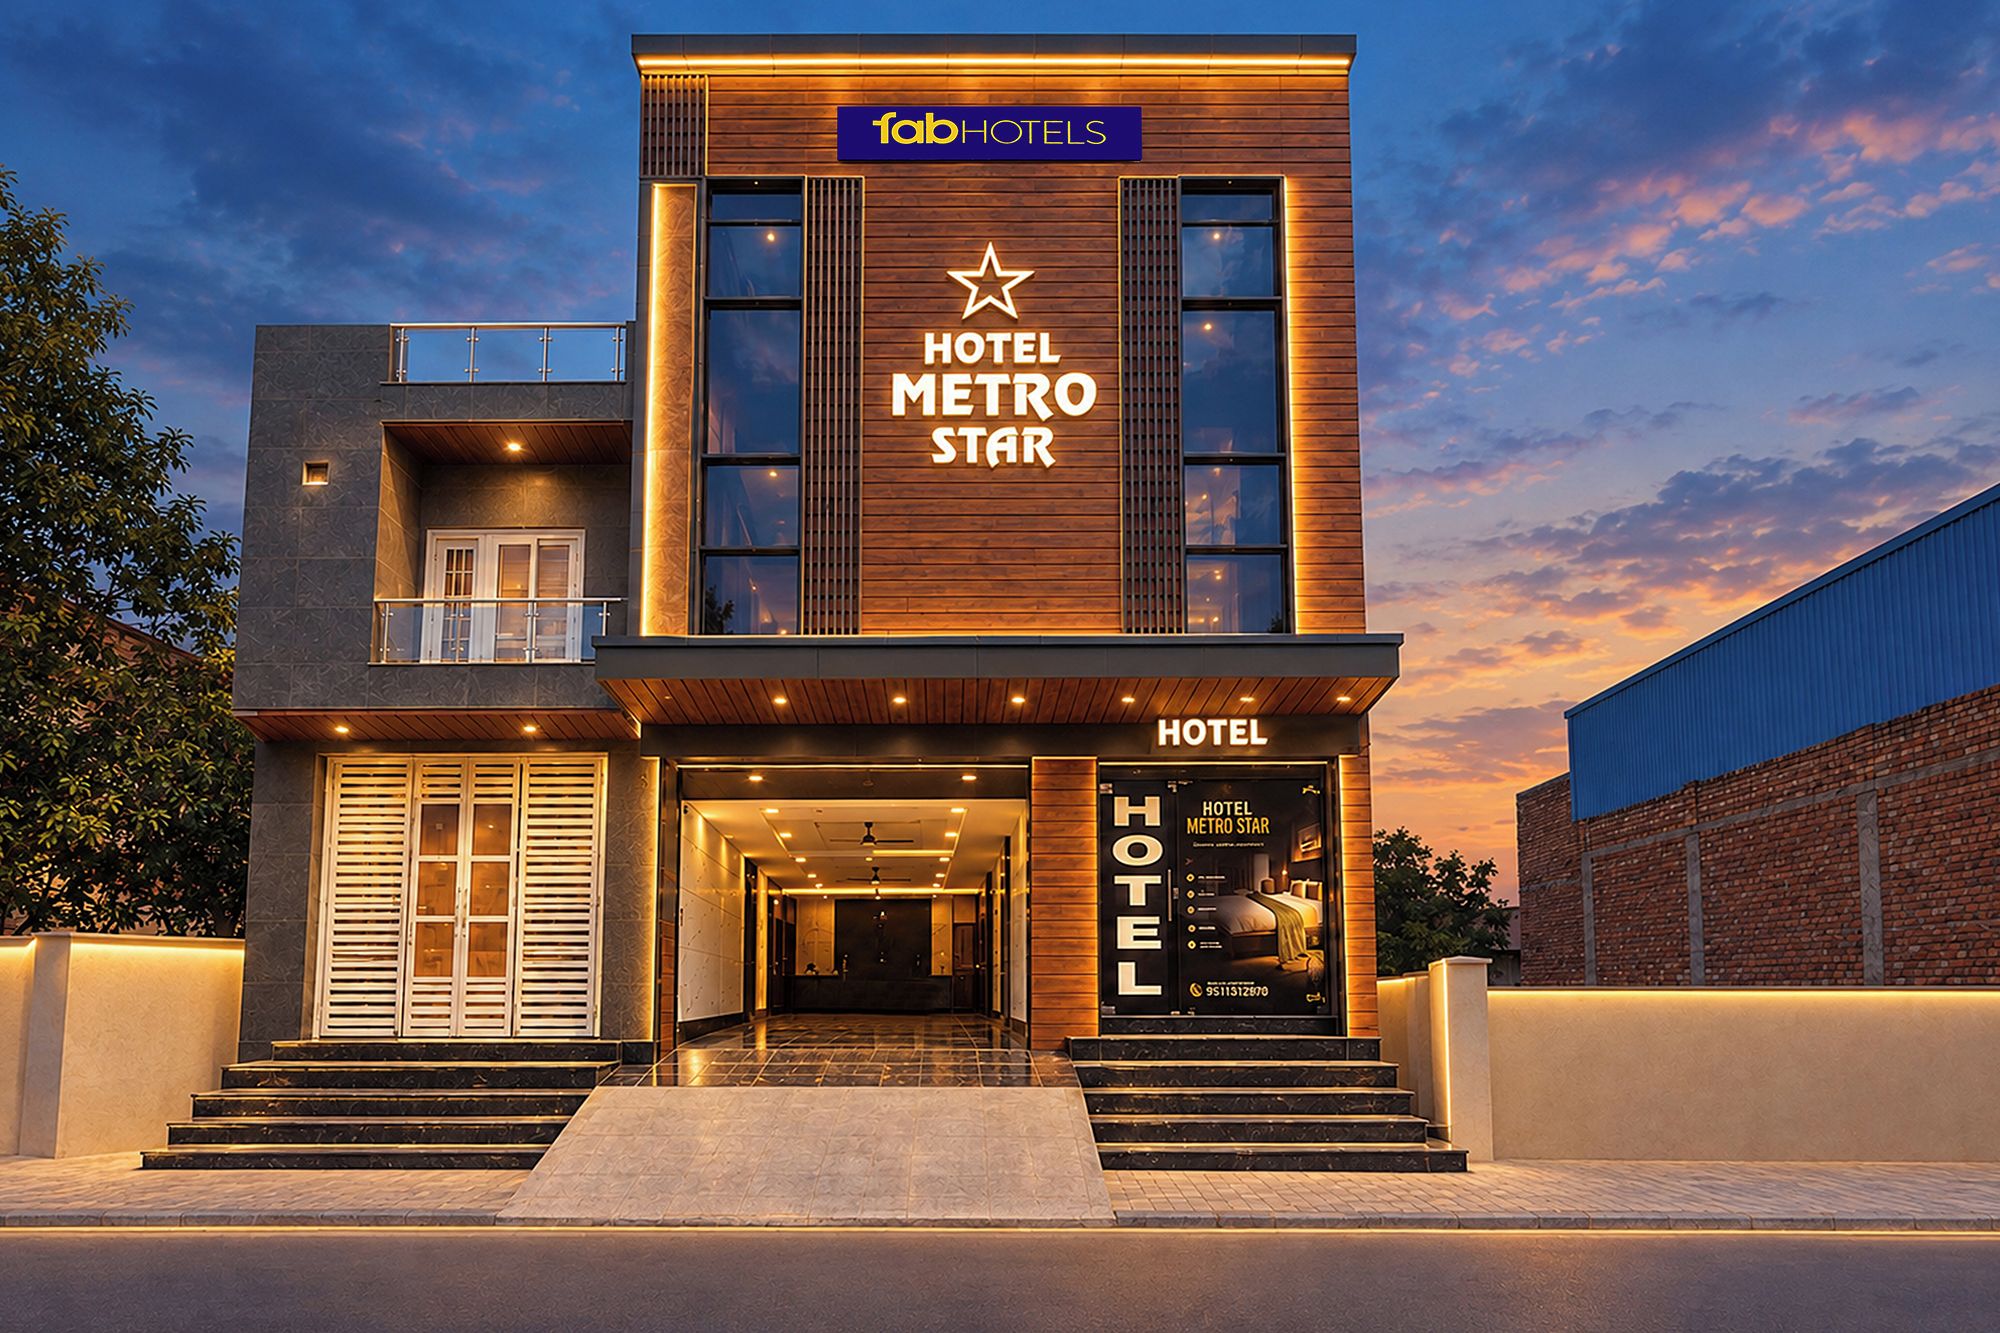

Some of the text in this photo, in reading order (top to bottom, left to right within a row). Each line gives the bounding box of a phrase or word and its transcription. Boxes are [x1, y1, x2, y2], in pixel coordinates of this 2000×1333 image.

[924, 332, 1061, 364] HOTEL
[892, 372, 1097, 421] METRO
[931, 427, 1056, 468] STAR
[1158, 718, 1268, 746] HOTEL
[1203, 801, 1253, 816] HOTEL
[1187, 817, 1270, 834] METRO STAR
[1112, 796, 1163, 995] HOTEL
